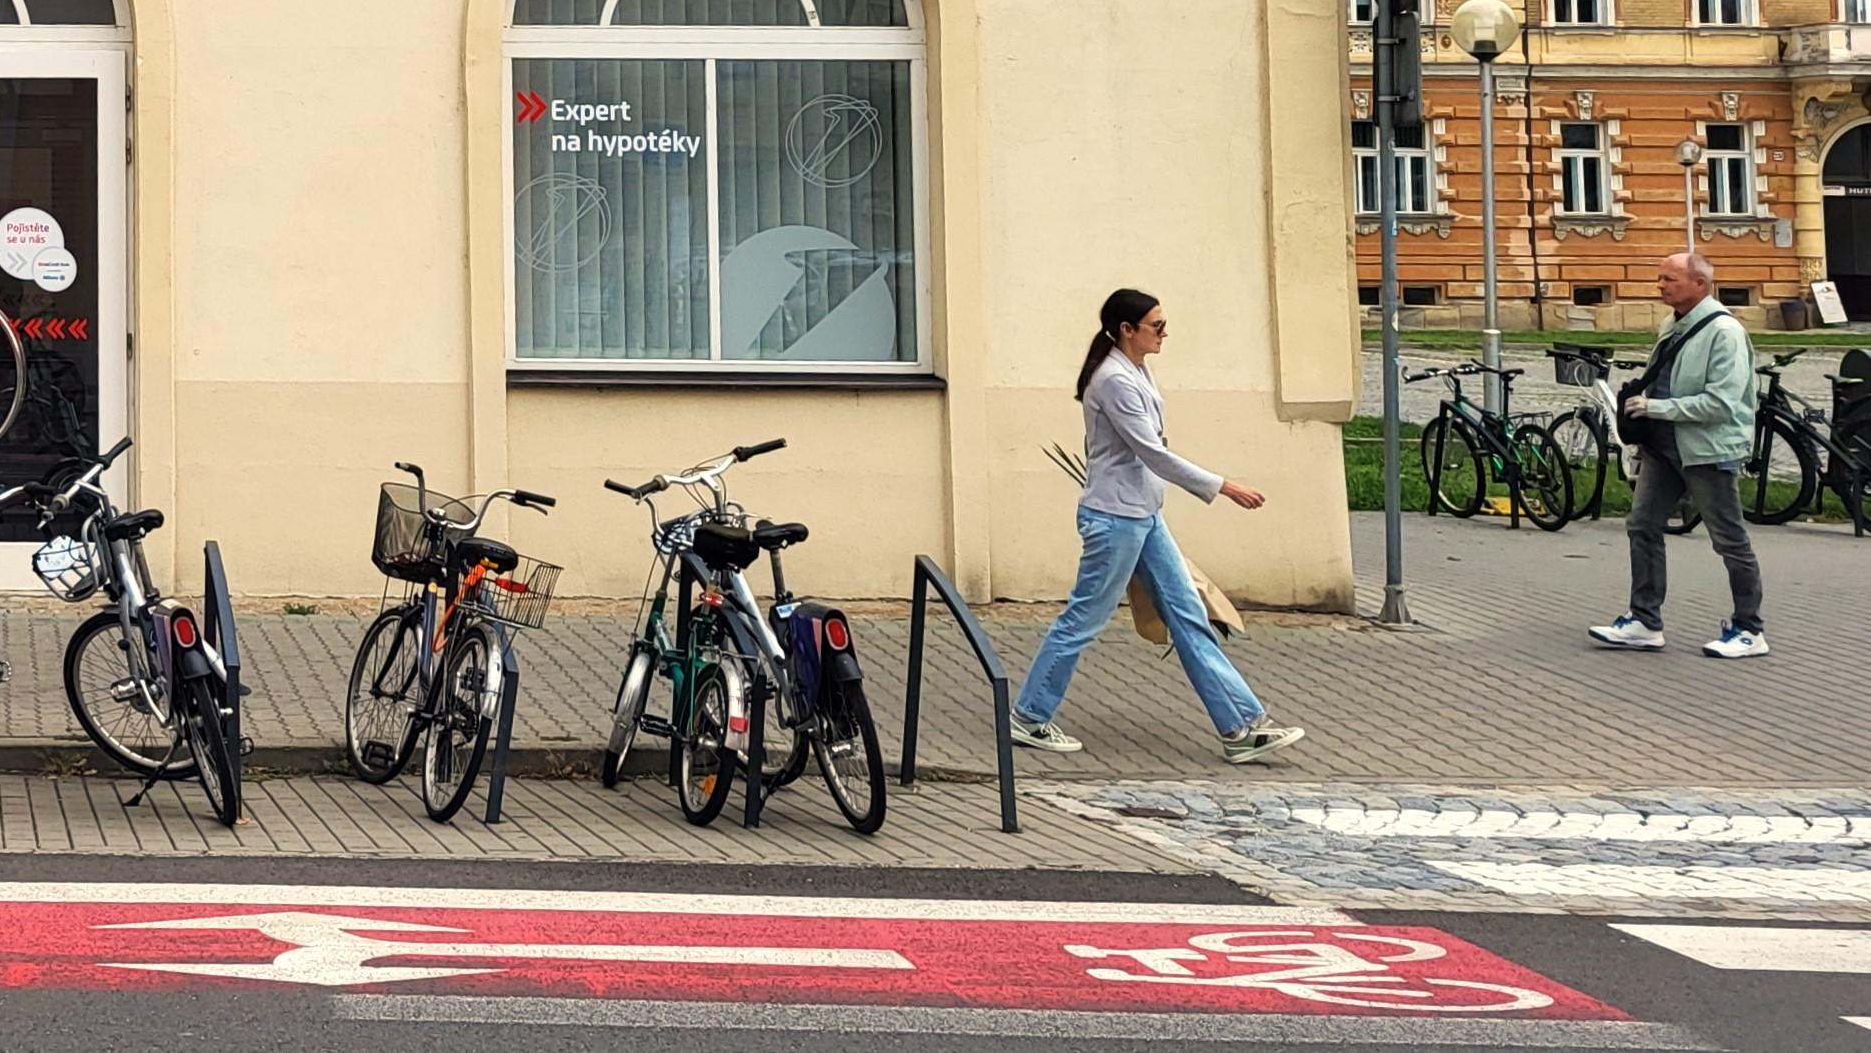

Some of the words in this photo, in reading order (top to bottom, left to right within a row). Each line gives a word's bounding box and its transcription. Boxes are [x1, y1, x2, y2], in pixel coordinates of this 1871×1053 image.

[551, 100, 631, 126] Expert
[552, 134, 581, 152] na
[588, 129, 700, 158] hypotéky
[7, 236, 18, 244] se
[29, 234, 46, 244] nás
